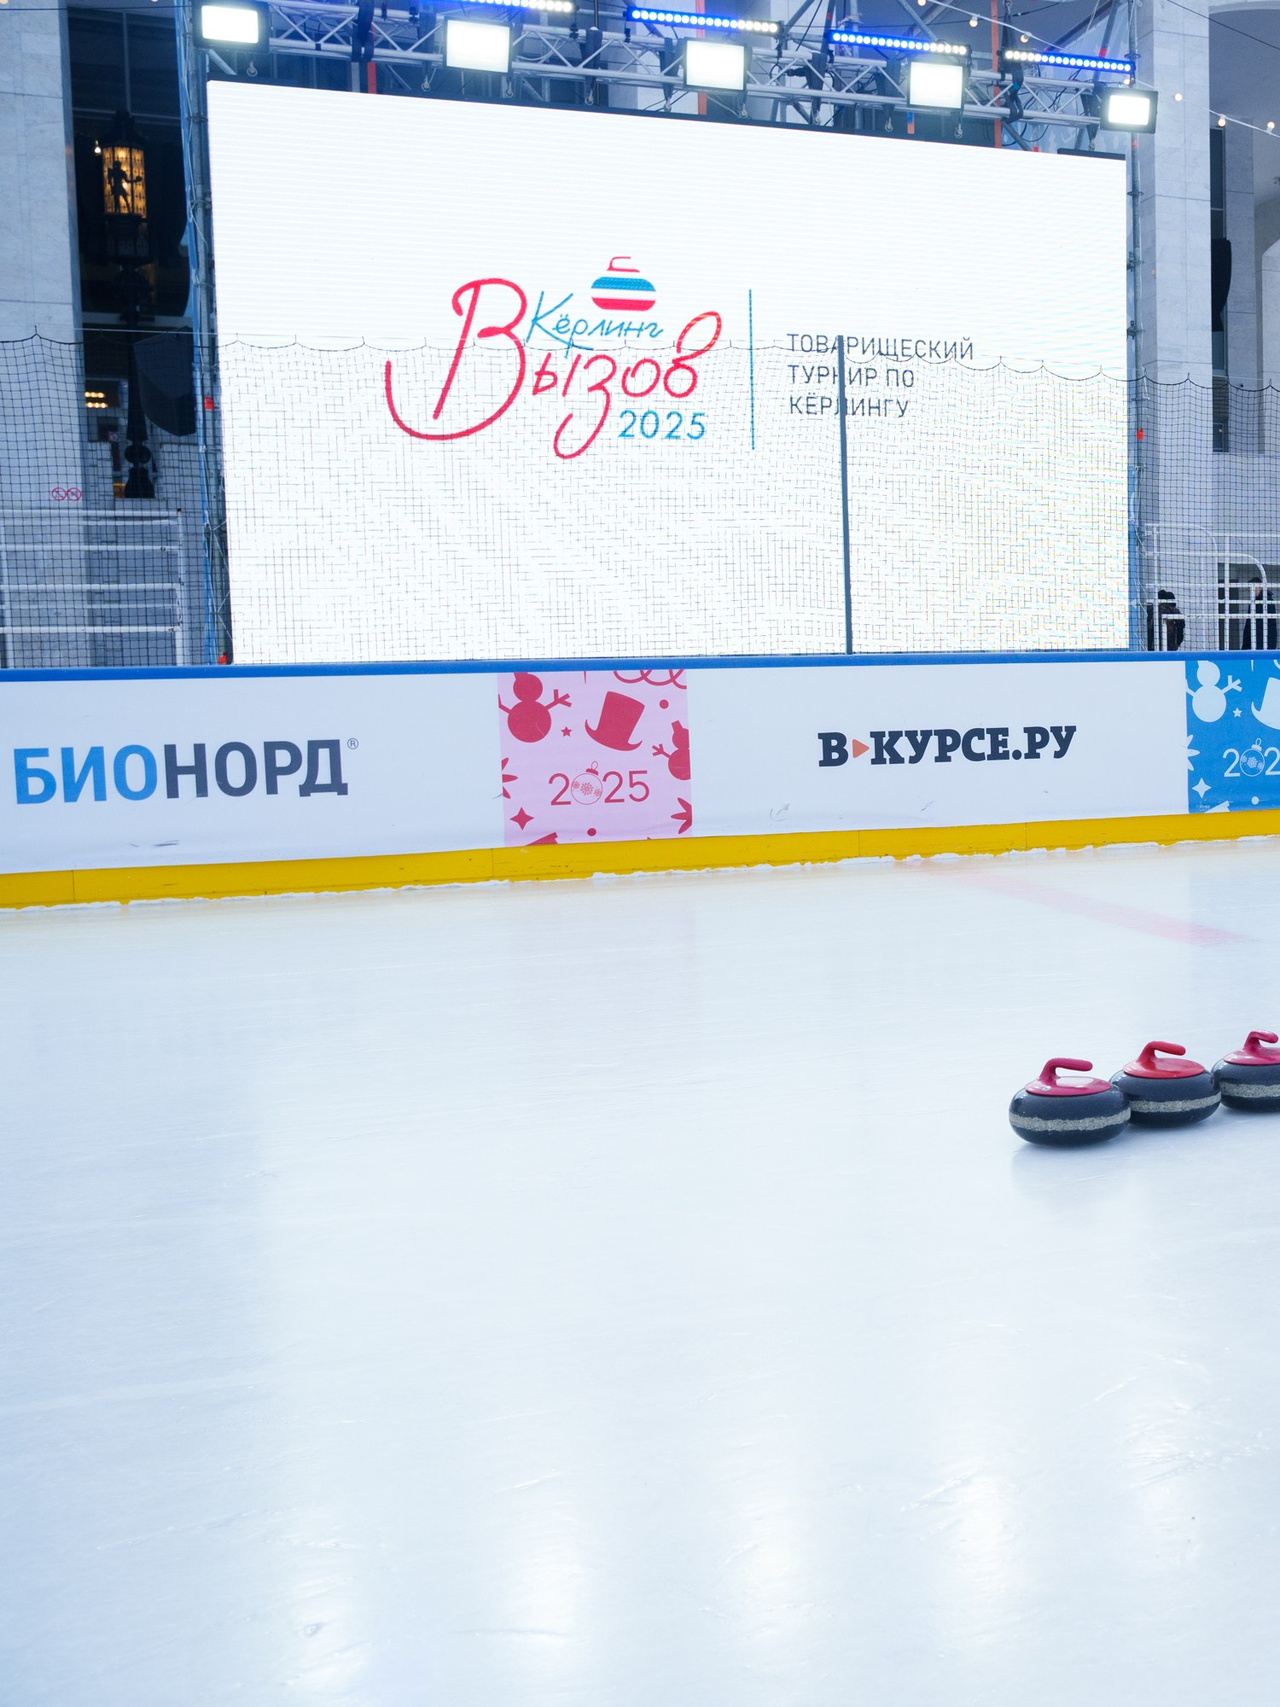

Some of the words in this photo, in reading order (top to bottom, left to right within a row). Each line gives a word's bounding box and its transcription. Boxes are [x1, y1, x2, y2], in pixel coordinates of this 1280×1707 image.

[525, 290, 665, 360] Кёрлинг
[385, 277, 723, 460] Вызов
[886, 368, 915, 389] ПО
[617, 408, 707, 441] 2025
